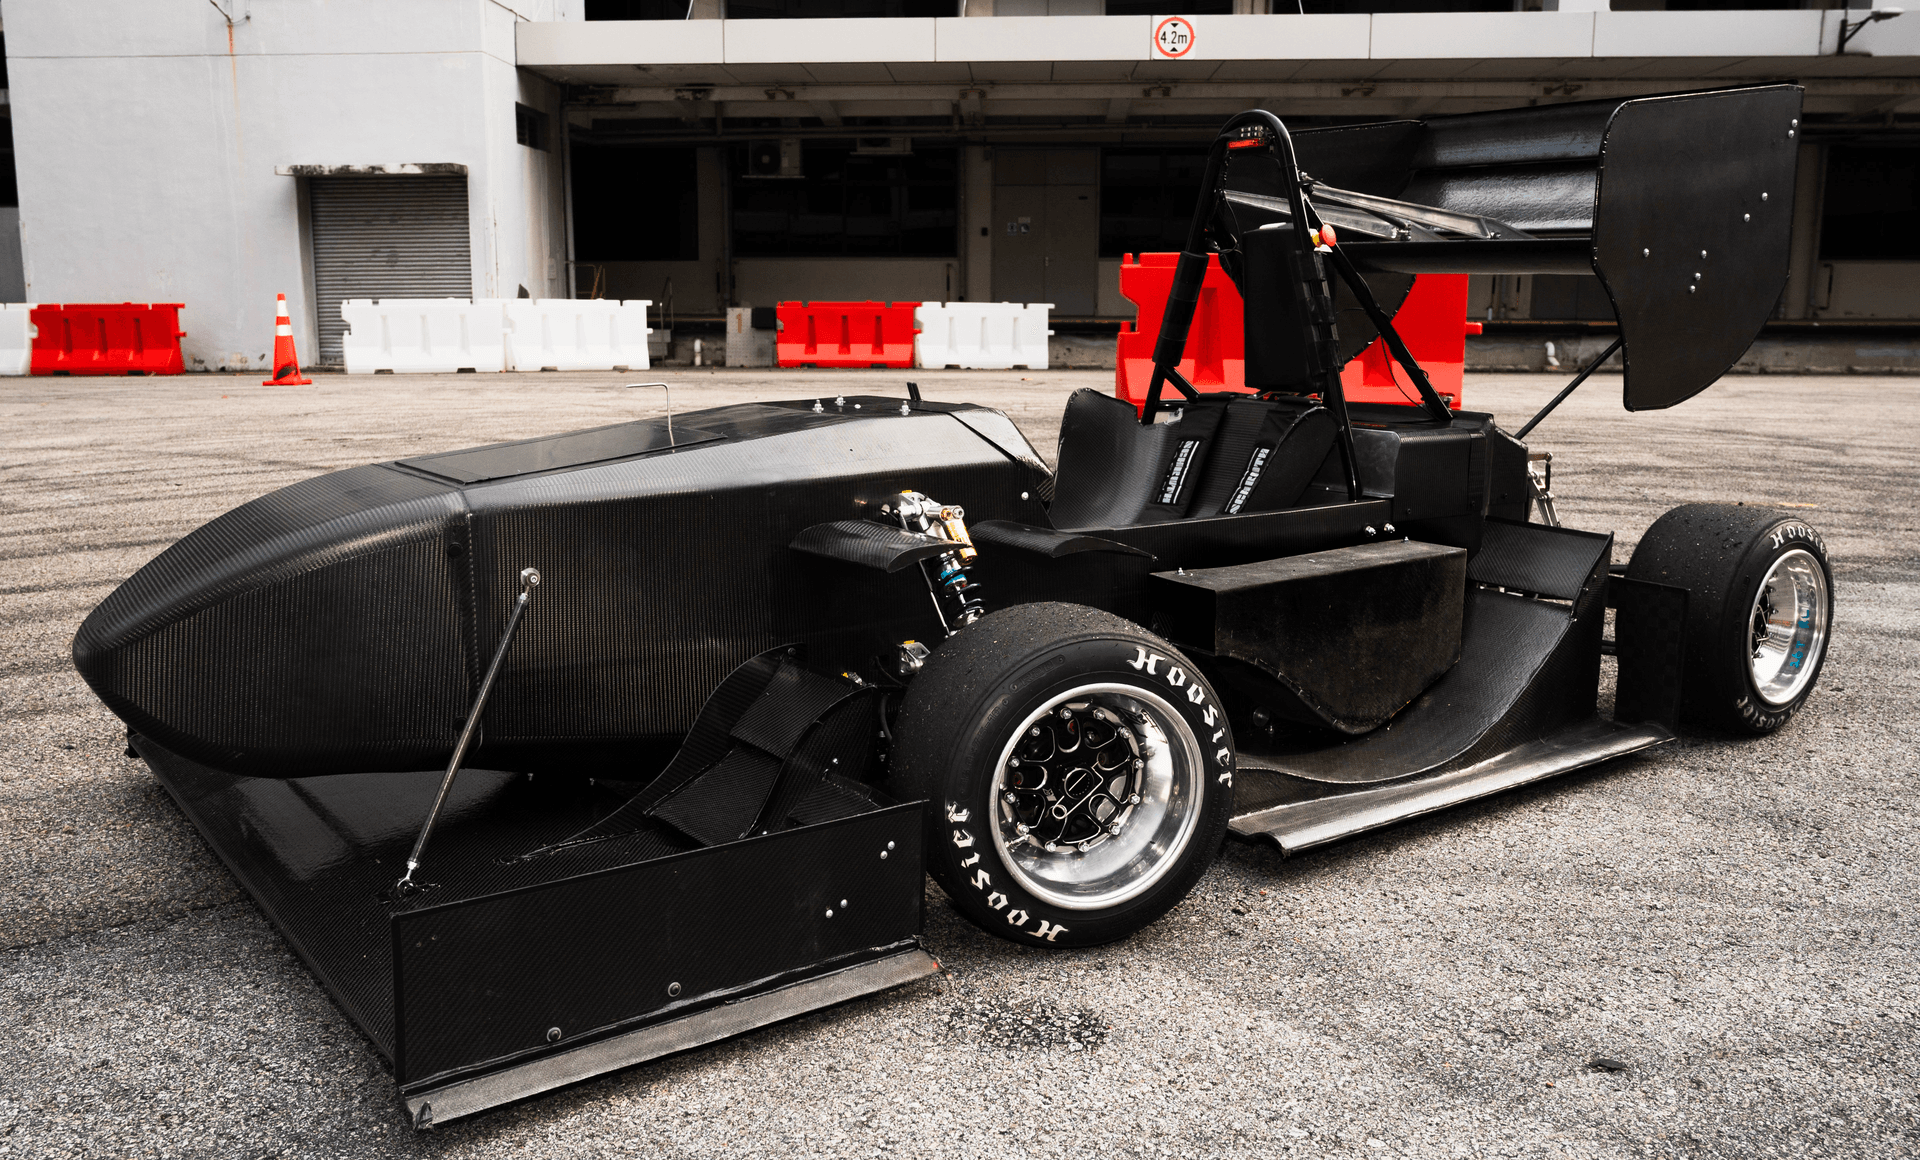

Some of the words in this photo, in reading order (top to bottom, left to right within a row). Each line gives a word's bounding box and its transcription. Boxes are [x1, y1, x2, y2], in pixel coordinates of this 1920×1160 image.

[1160, 31, 1188, 44] 4.2m
[1161, 440, 1194, 503] SCHROTH
[1229, 448, 1270, 514] SCHROTH
[1126, 646, 1232, 788] Hoosier
[947, 801, 1069, 942] Hoosier
